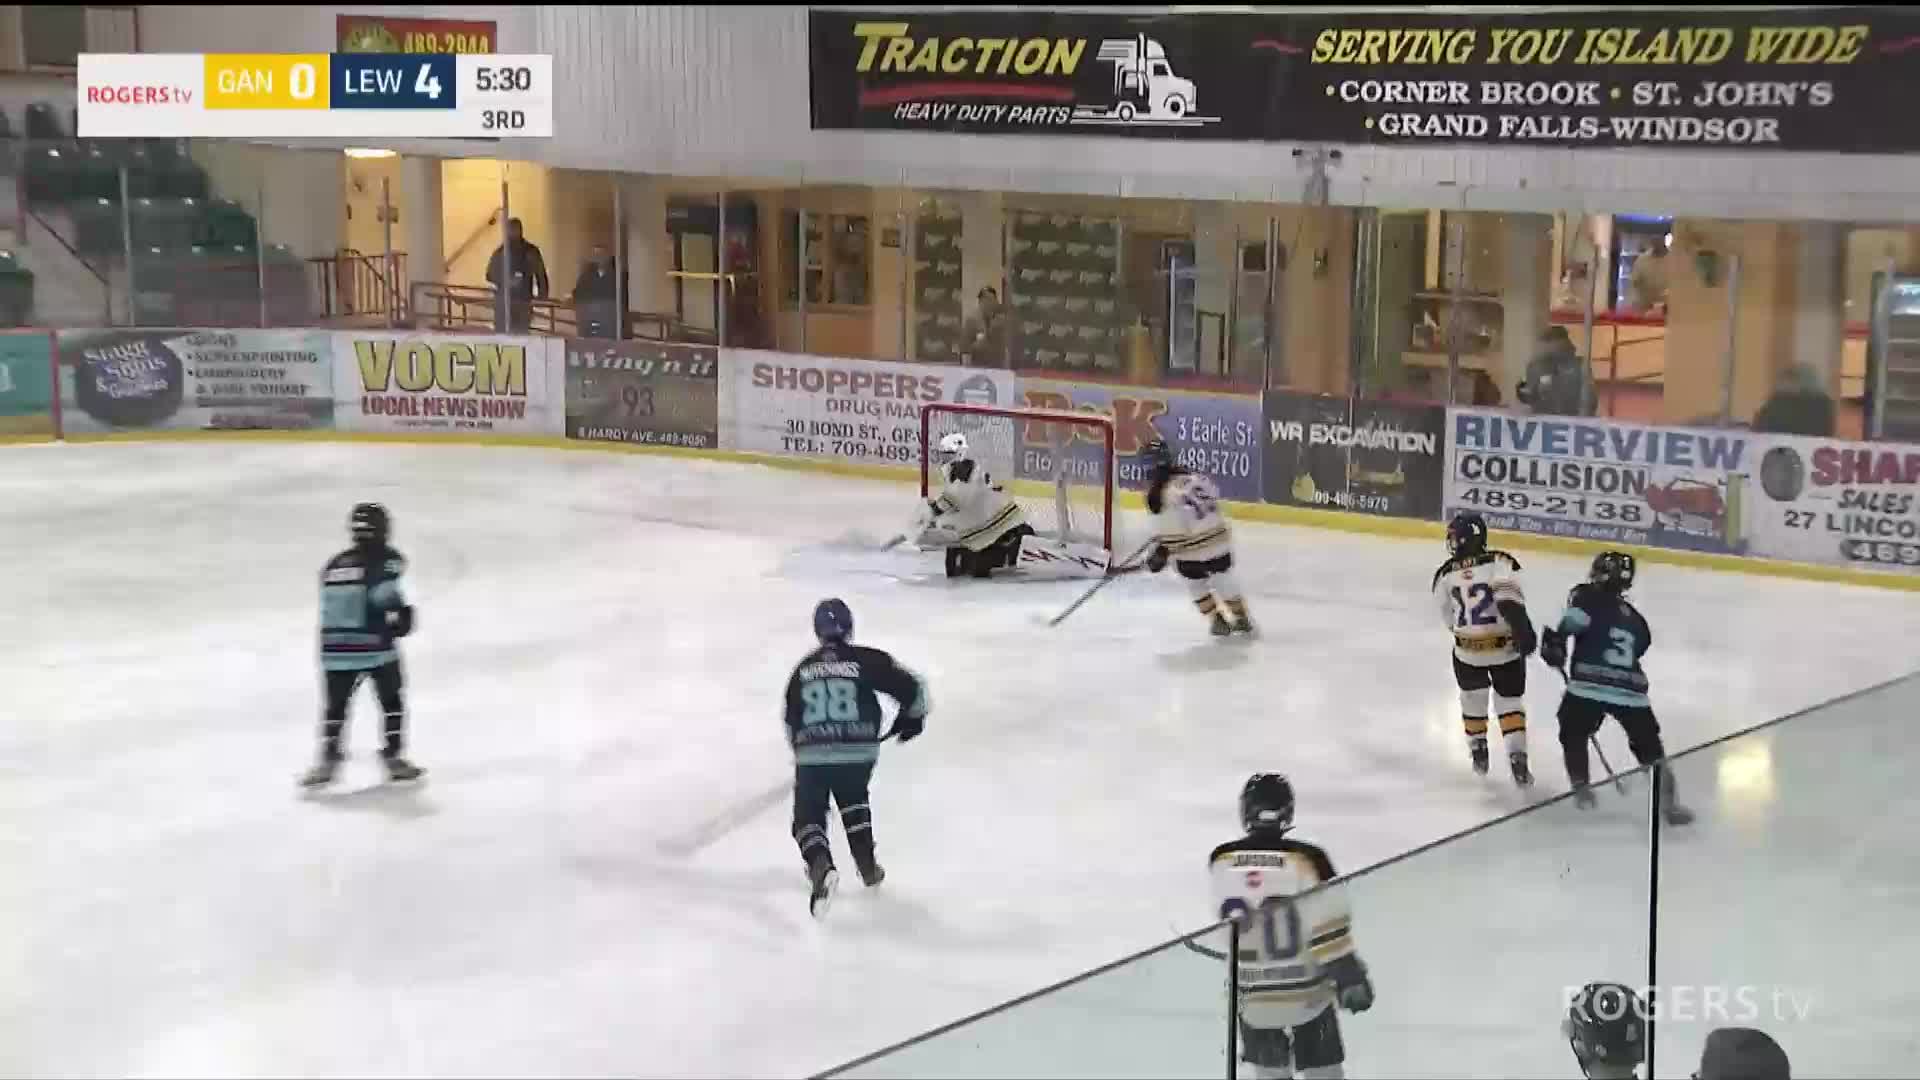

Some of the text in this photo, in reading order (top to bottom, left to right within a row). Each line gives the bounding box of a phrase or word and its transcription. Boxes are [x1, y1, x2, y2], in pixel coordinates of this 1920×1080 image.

[853, 22, 1087, 75] TRACTION
[1311, 25, 1869, 64] SERVING YOU ISLAND WIDE
[1340, 80, 1834, 106] CORNER BROOK ST. JOHN'S
[894, 103, 1070, 124] HEAVY DUTY PARTS
[1378, 113, 1780, 142] GRAND FALLS-WINDSOR
[354, 340, 527, 396] VOCM
[751, 362, 943, 400] SHOPPERS
[361, 395, 526, 419] LOCAL NEWS NOW
[826, 399, 880, 416] DRUG
[1177, 417, 1187, 441] 3
[1192, 418, 1230, 443] Earle
[1270, 421, 1436, 455] WR EXCAVATION
[1455, 415, 1746, 470] RIVERVIEW
[1023, 451, 1099, 477] Floring
[1460, 454, 1646, 494] COLLISION
[1460, 488, 1641, 522] 489-2138
[1838, 488, 1913, 514] SALES
[1784, 510, 1920, 538] 27 LINCO
[1452, 583, 1498, 627] 12
[1603, 626, 1636, 667] 3
[802, 679, 860, 726] 98
